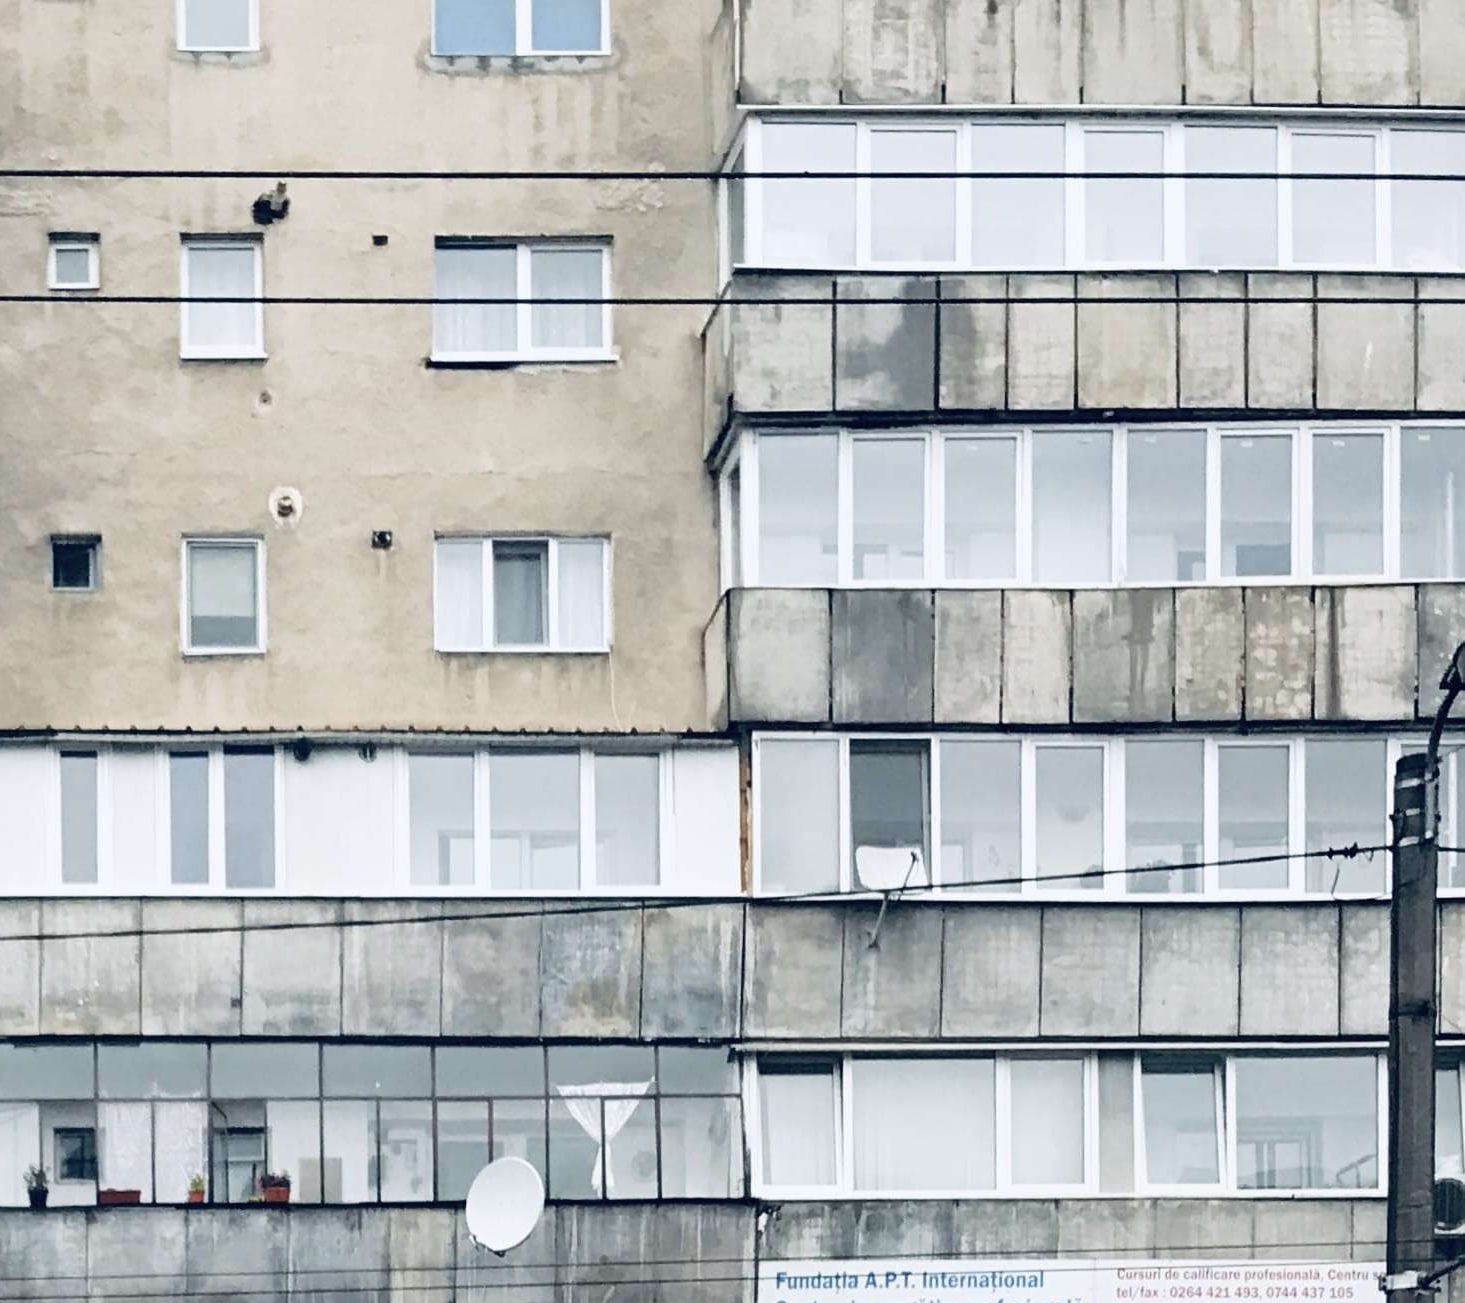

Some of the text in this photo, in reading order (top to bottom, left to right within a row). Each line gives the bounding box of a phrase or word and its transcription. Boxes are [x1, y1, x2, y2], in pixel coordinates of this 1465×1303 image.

[864, 1271, 916, 1289] A.P.T.
[1116, 1268, 1161, 1281] Cursuri
[1164, 1268, 1180, 1280] de
[1183, 1268, 1241, 1281] calificare
[1327, 1269, 1369, 1281] Centru
[1116, 1286, 1159, 1299] tel/fax
[1169, 1286, 1203, 1299] 0264
[1206, 1286, 1231, 1298] 421
[1234, 1287, 1263, 1301] 493,
[1266, 1287, 1297, 1299] 0744
[1300, 1287, 1325, 1299] 437
[1329, 1287, 1354, 1299] 105
